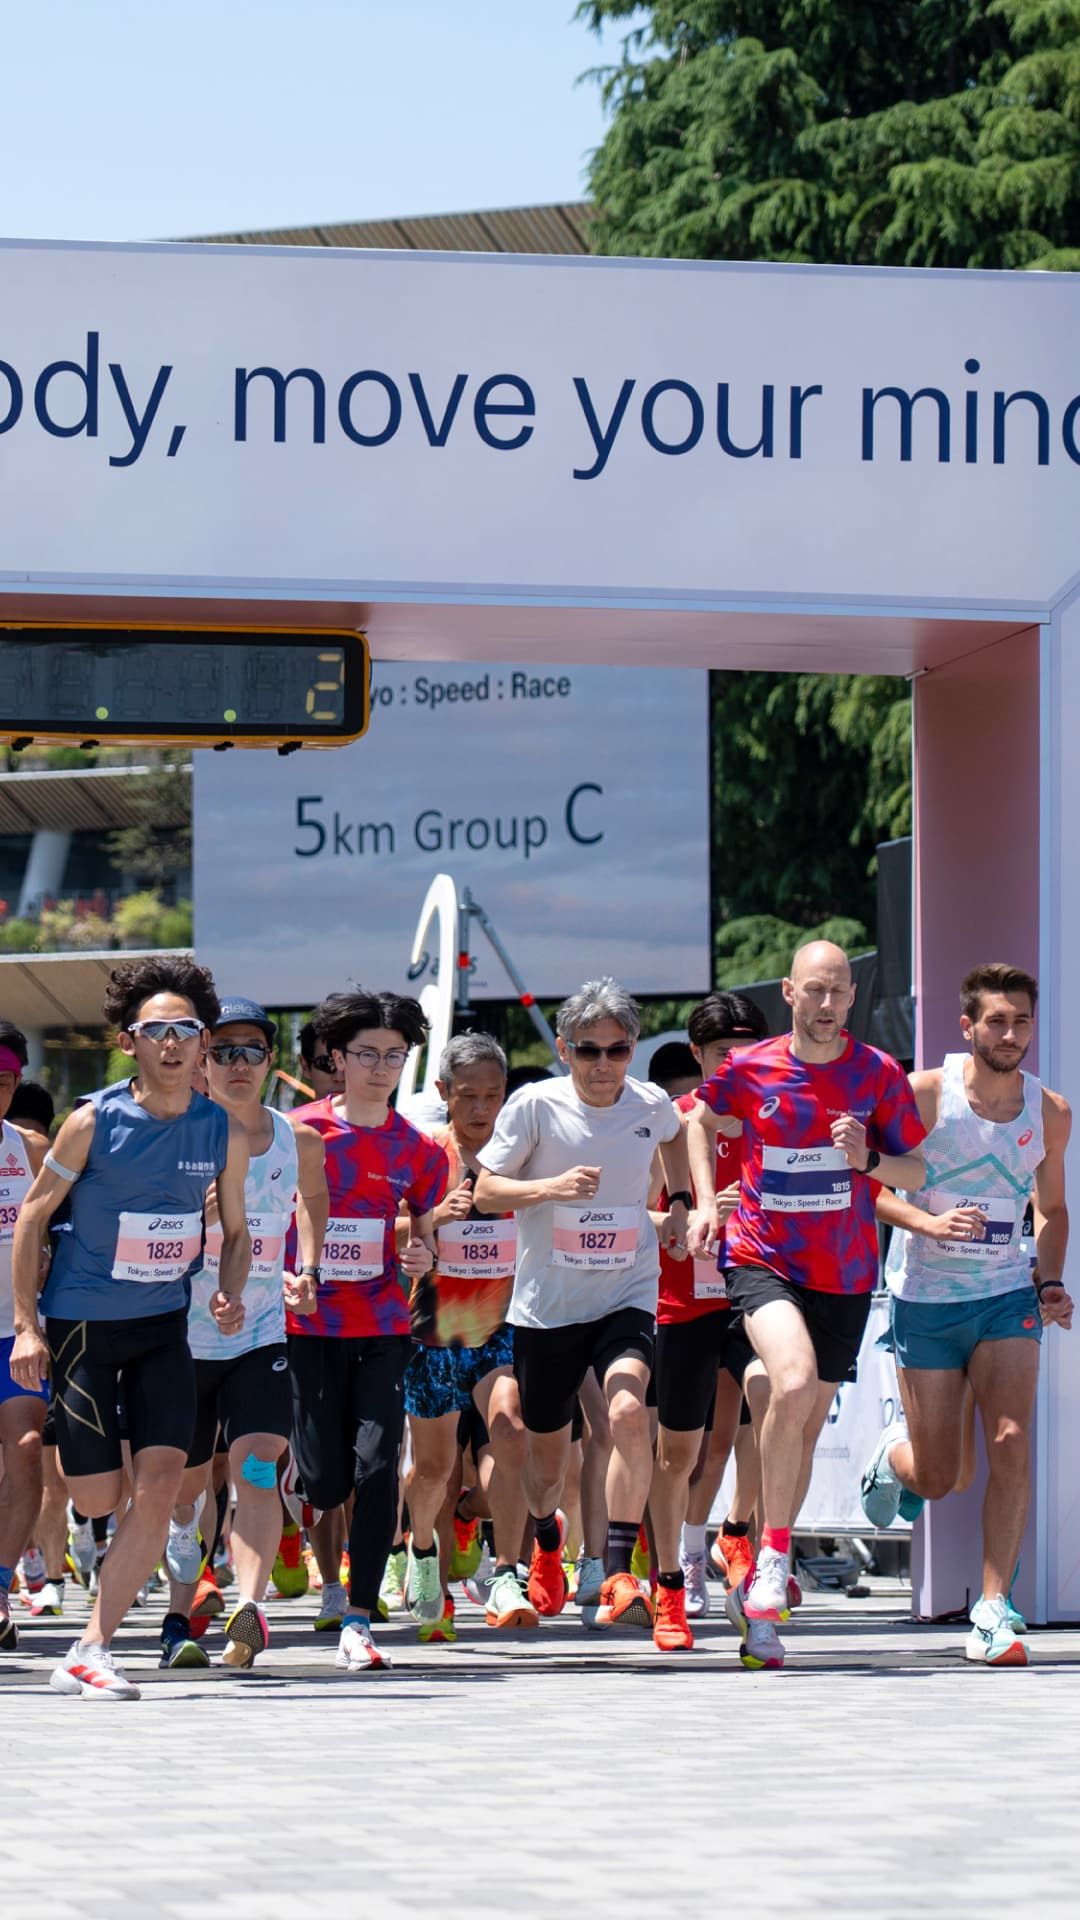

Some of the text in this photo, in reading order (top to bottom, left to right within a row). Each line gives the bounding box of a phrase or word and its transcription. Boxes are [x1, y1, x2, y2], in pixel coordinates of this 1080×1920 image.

[234, 366, 536, 451] move
[572, 377, 823, 481] your
[414, 672, 490, 710] Speed
[511, 671, 571, 699] Race
[295, 781, 604, 860] 5km Group C
[832, 1180, 851, 1193] 1815
[772, 1198, 793, 1209] Tokyo
[798, 1199, 820, 1209] Speed
[825, 1198, 842, 1206] Race
[578, 1232, 617, 1249] 1827
[991, 1233, 1010, 1243] 1805
[146, 1241, 184, 1260] 1823
[322, 1243, 361, 1261] 1826
[462, 1243, 499, 1260] 1834
[960, 1246, 981, 1255] Speed
[563, 1254, 583, 1265] Tokyo
[588, 1257, 610, 1266] Speed
[127, 1266, 150, 1277] Tokyo
[154, 1267, 173, 1276] Speed
[331, 1268, 353, 1276] Speed
[448, 1265, 467, 1275] Tokyo
[472, 1266, 492, 1275] Speed
